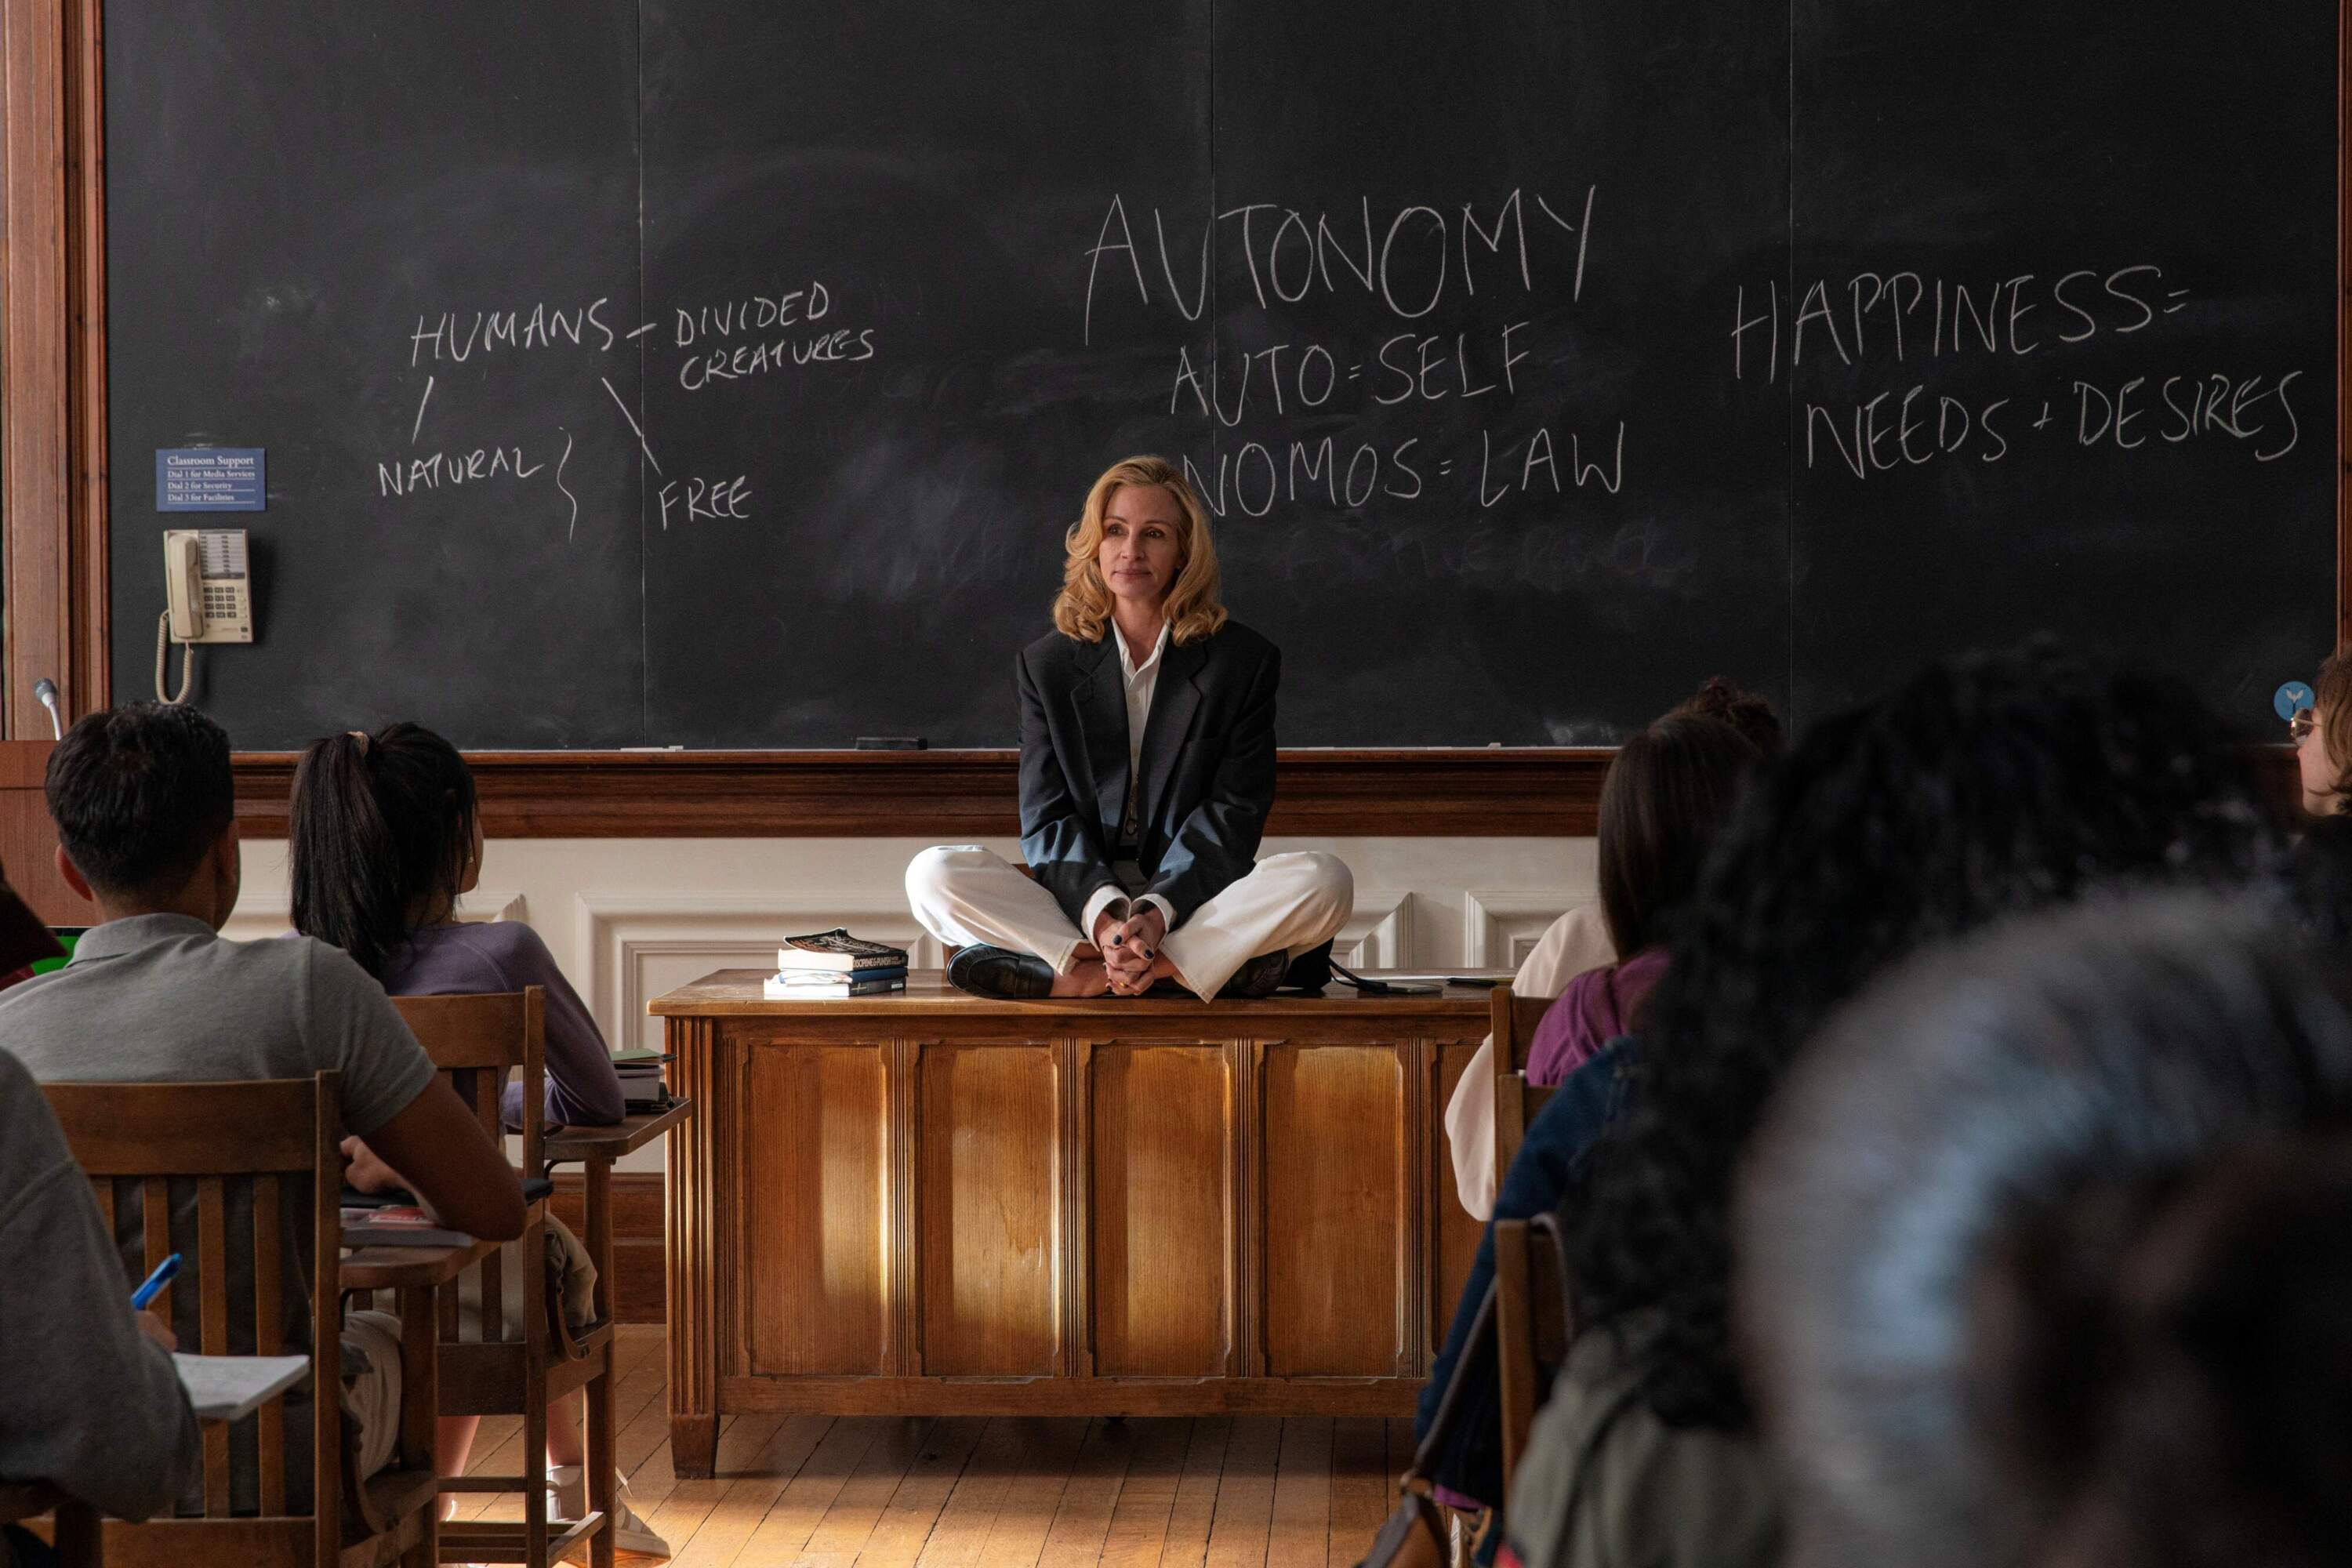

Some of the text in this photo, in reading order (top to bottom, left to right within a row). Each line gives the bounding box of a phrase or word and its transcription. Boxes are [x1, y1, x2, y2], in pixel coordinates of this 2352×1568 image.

[1085, 185, 1595, 345] AUTONOMY
[411, 298, 613, 366] HUMANS
[677, 281, 829, 347] DIVIDED
[680, 329, 874, 390] CREATURES
[1807, 385, 2009, 479] NEEDS
[2074, 371, 2303, 460] DESIRES
[167, 456, 254, 468] Classroom Support
[379, 447, 544, 495] NATURAL
[1481, 421, 1624, 507] LAW
[659, 476, 751, 531] FREE
